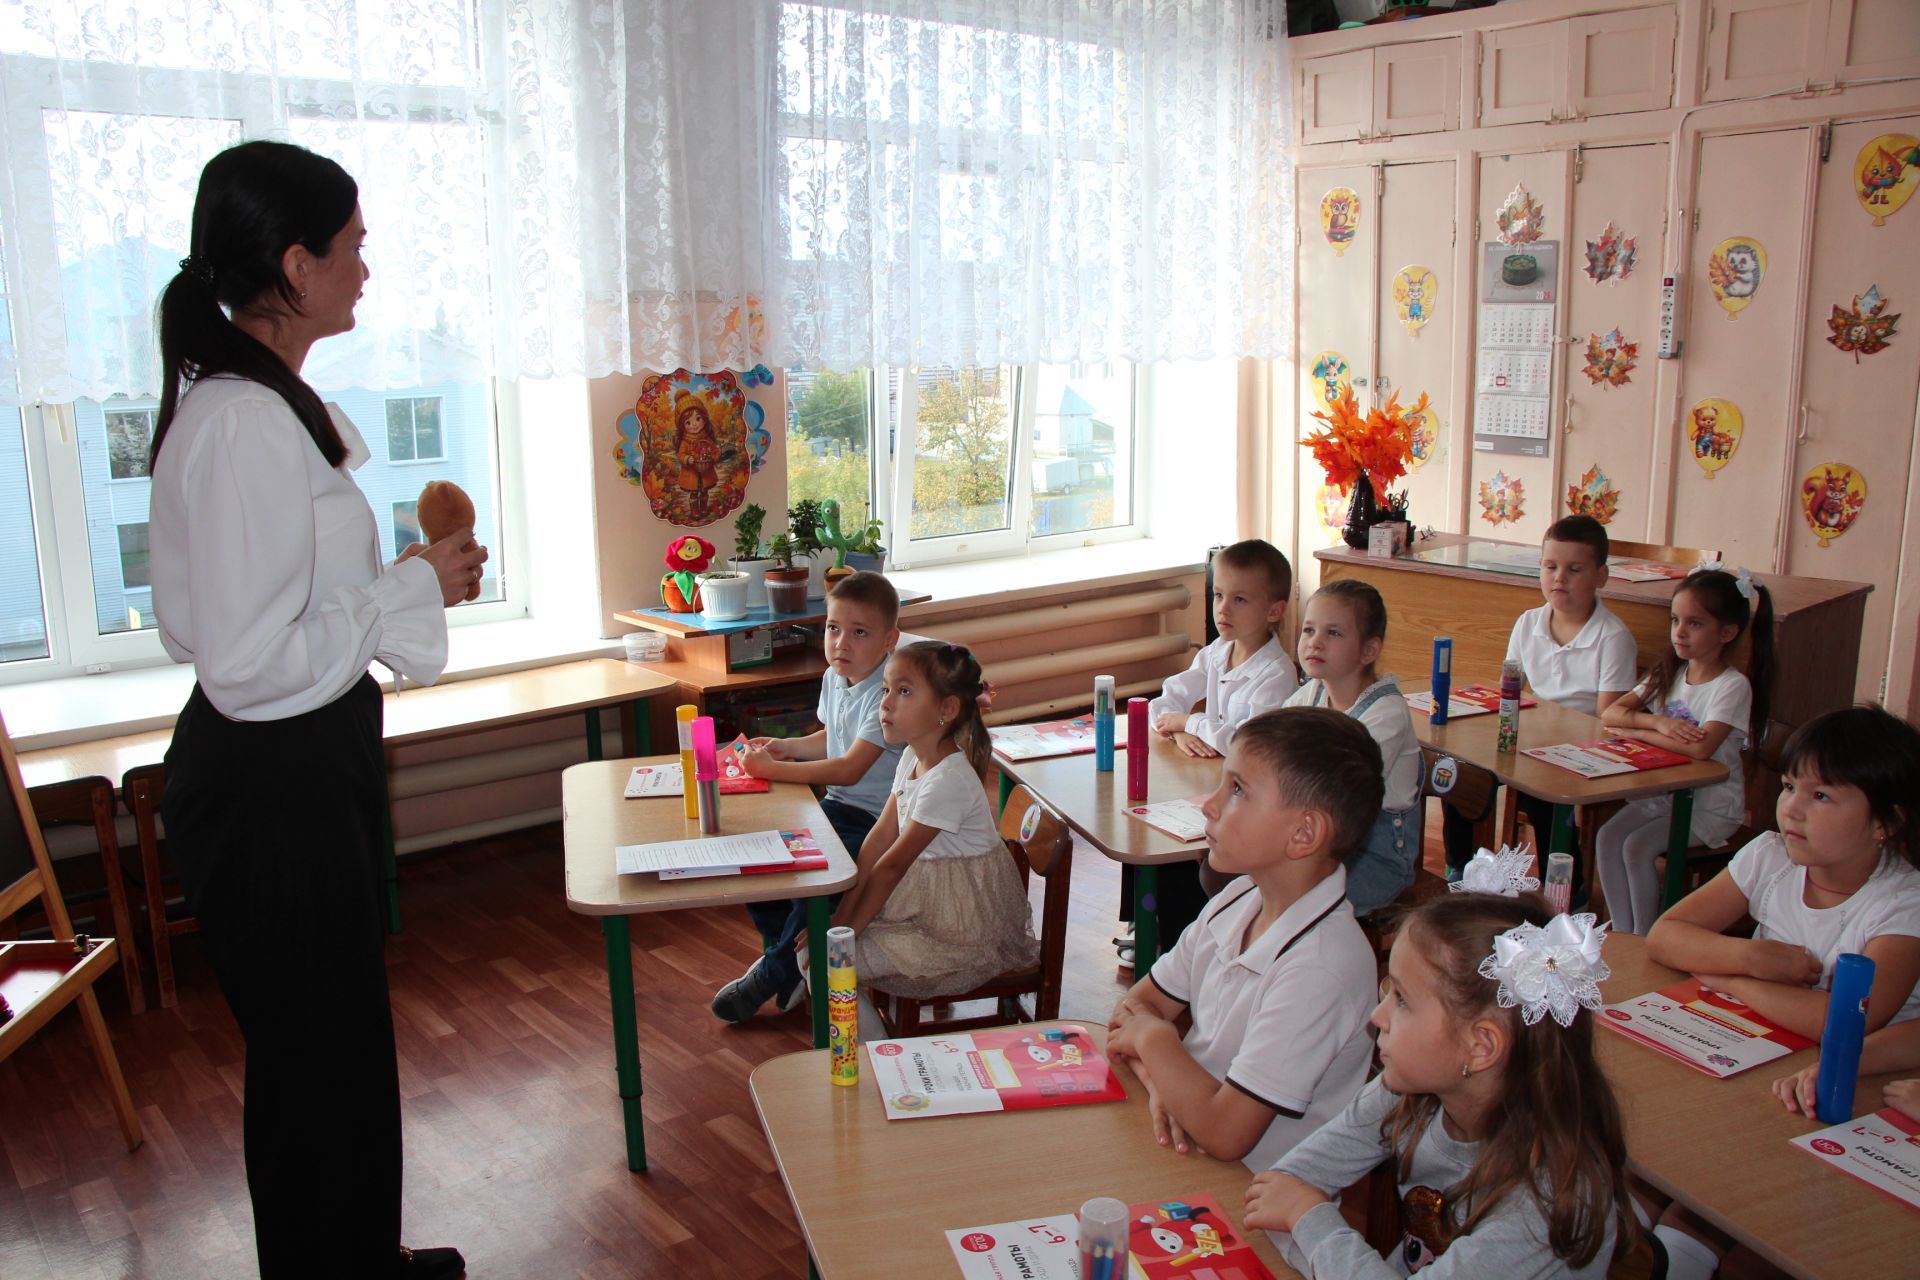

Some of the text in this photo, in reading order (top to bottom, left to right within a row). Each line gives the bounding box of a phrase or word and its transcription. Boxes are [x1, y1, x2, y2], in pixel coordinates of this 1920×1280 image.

[1639, 1014, 1688, 1036] ГРАМОТЫ
[1687, 1034, 1722, 1050] УРОКИ
[912, 1052, 935, 1094] УРОКИ ГРАМОТЫ
[1856, 1145, 1918, 1178] ГРАМОТЫ
[1008, 1245, 1035, 1280] РАМОТЫ
